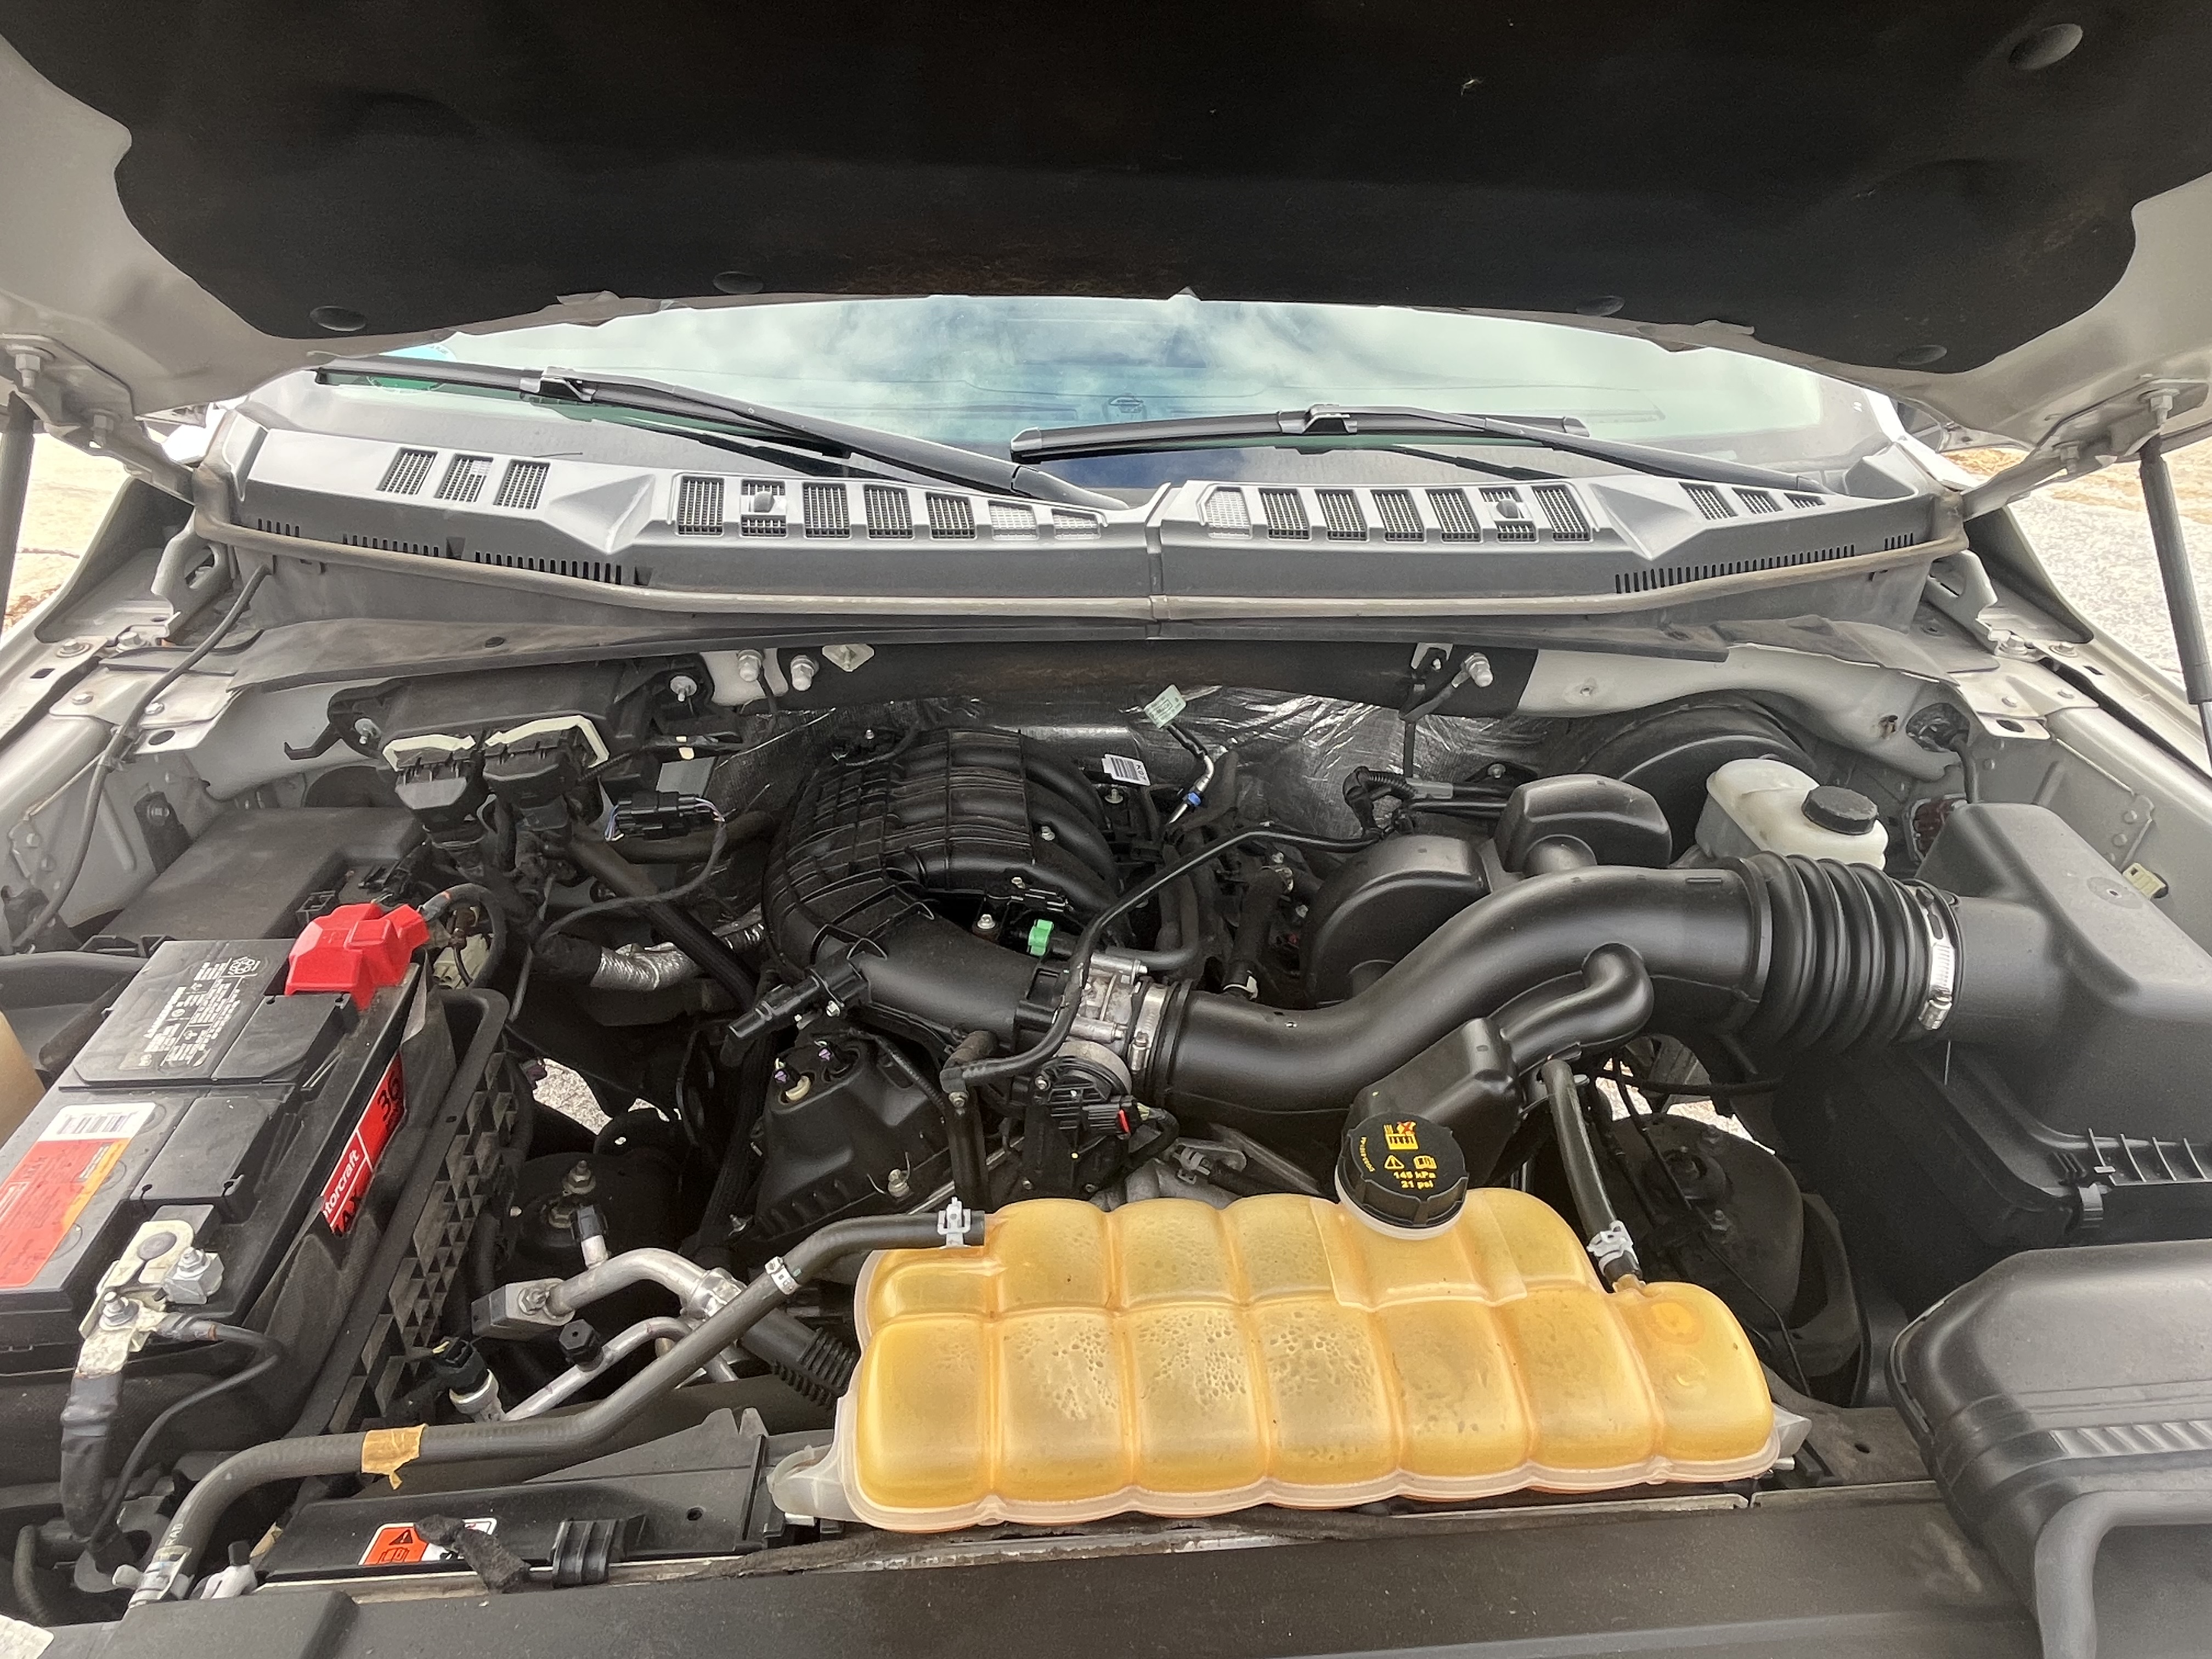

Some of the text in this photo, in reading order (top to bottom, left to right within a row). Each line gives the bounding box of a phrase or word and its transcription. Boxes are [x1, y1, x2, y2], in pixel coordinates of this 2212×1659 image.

[323, 1149, 360, 1218] torcraft
[1401, 1180, 1434, 1190] 21 psi
